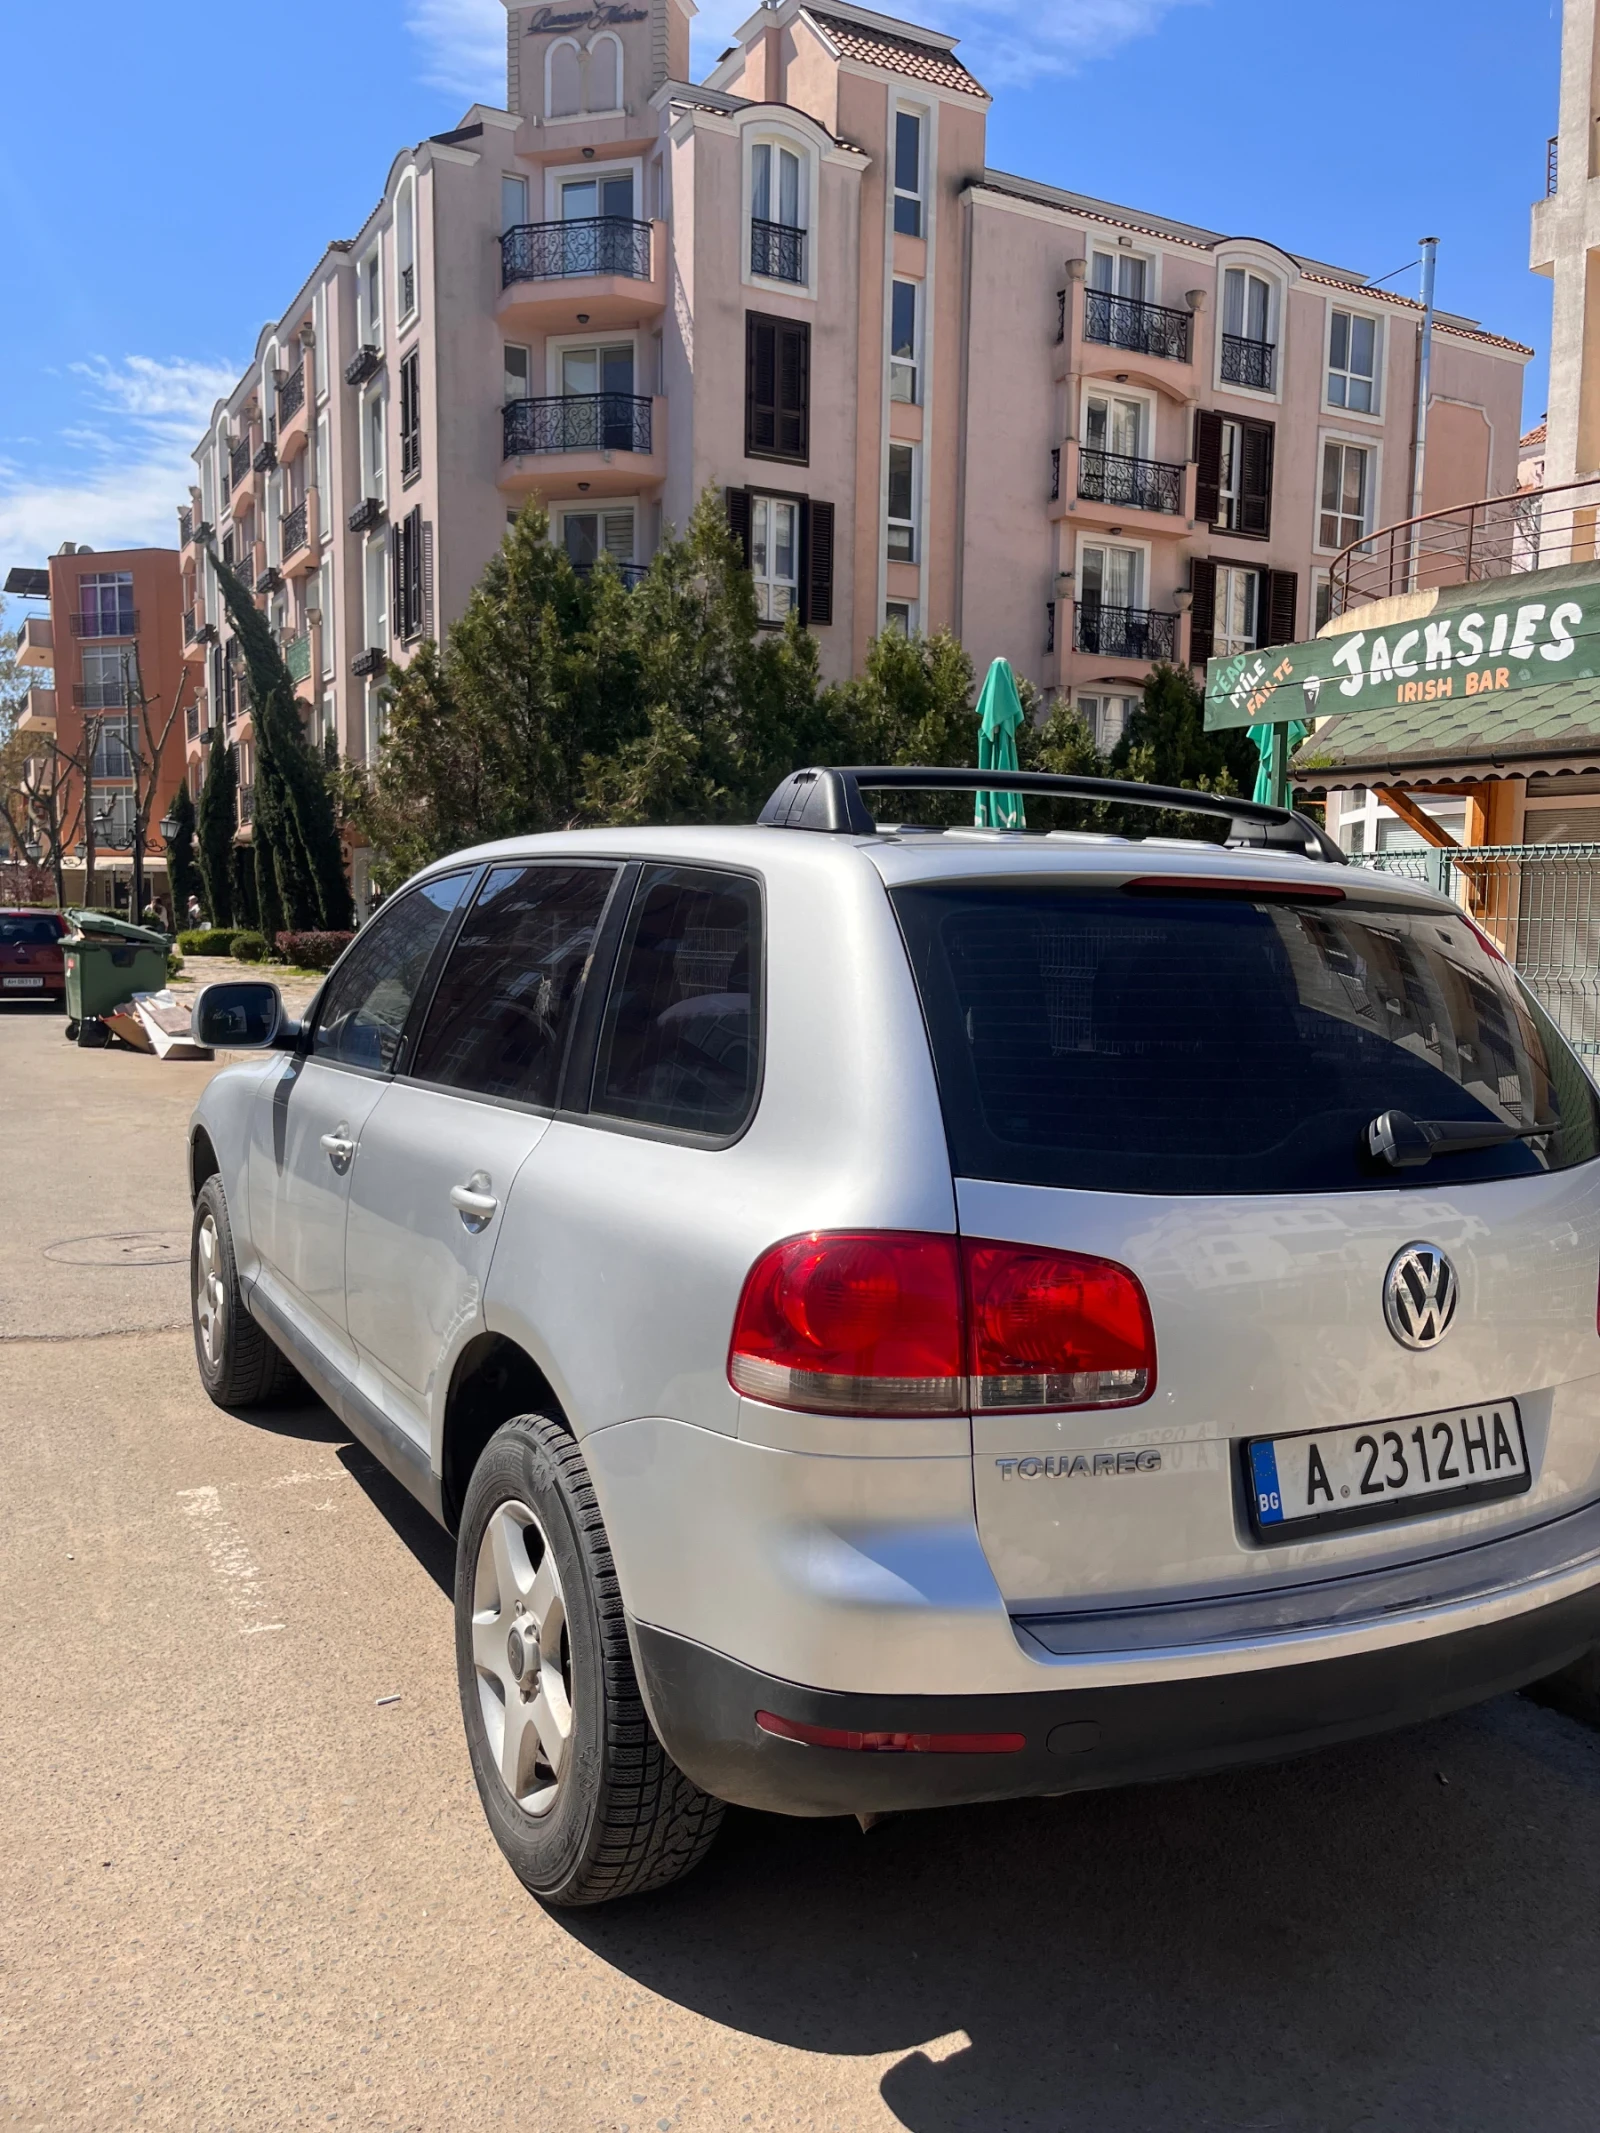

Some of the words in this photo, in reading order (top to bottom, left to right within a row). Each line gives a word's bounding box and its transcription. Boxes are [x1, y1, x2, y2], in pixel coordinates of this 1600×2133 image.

[1332, 602, 1583, 697] JACKSIES
[1397, 676, 1453, 703] IRISH
[1465, 667, 1510, 696] BAR
[995, 1449, 1162, 1481] TOUAREG
[1258, 1492, 1280, 1512] BG
